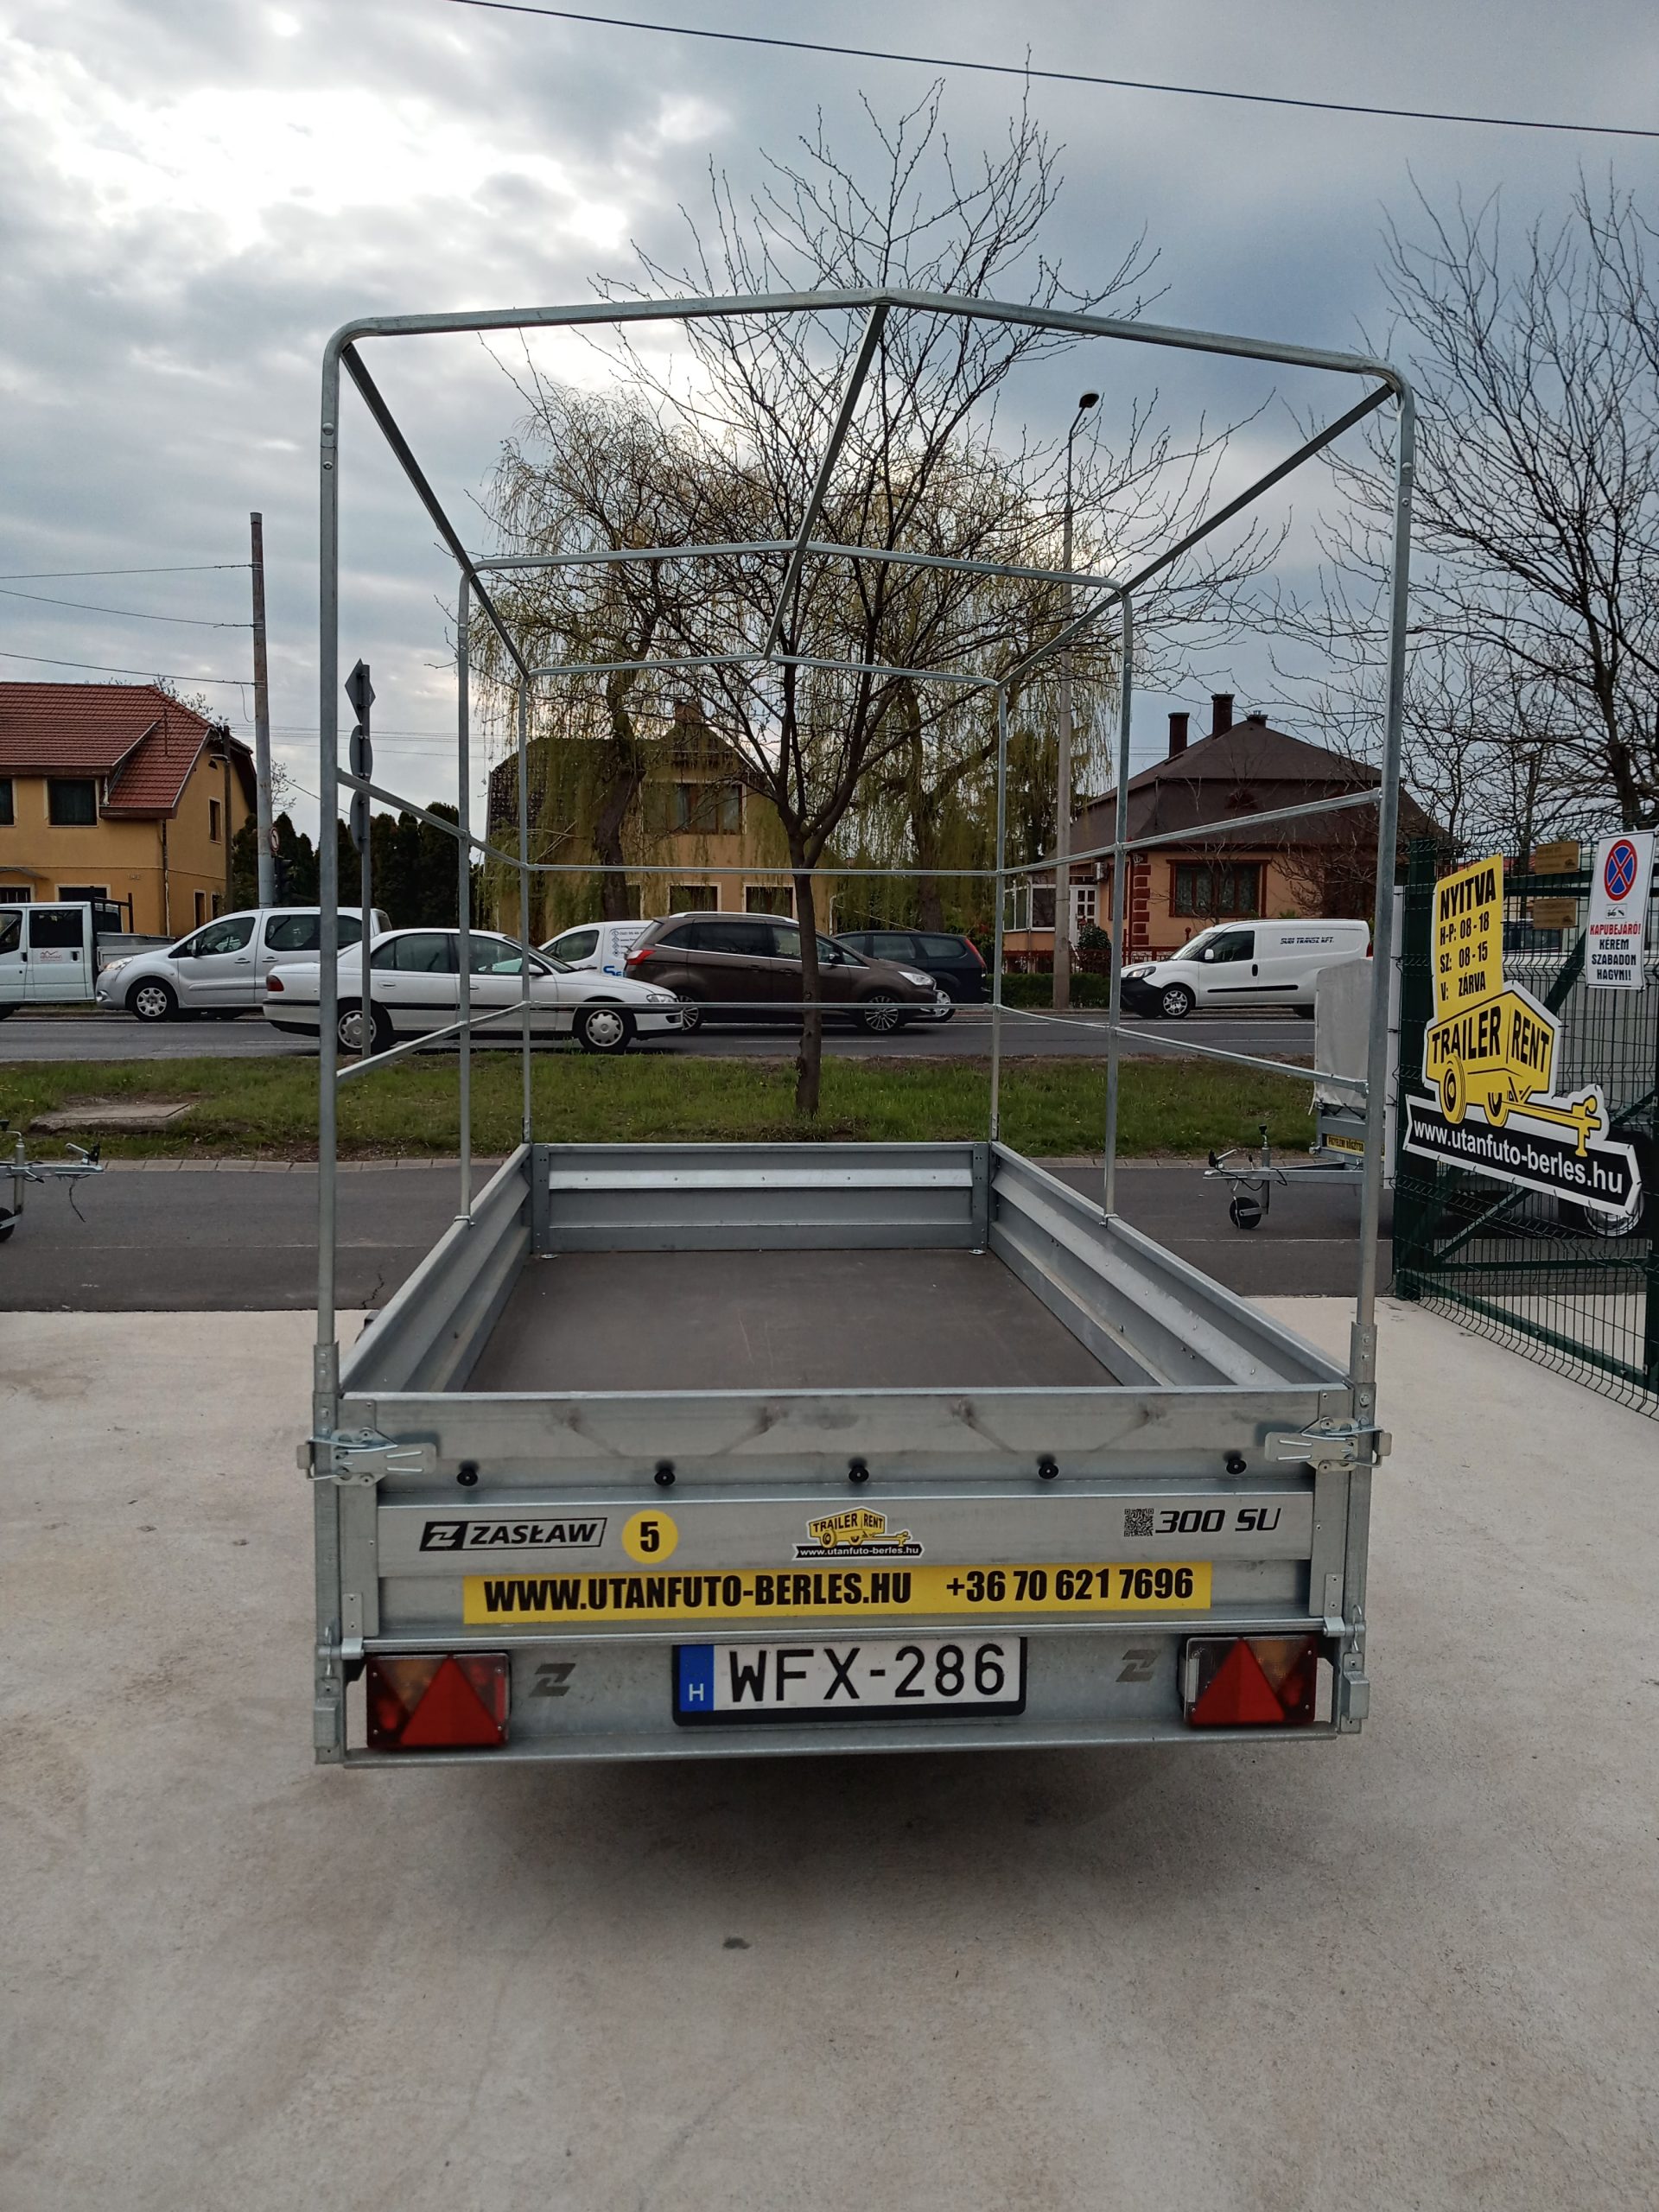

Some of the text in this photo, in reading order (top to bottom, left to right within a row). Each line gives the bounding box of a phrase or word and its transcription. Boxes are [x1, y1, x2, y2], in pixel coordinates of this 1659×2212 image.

[1440, 868, 1497, 922] NYITVA
[1440, 923, 1457, 946] H-P:
[1459, 917, 1471, 939] 08
[1478, 911, 1490, 932] 18
[1590, 921, 1641, 935] KAPUBEJÁRÓ!
[1599, 937, 1630, 950] KÉREM
[1440, 952, 1452, 974] SZ:
[1459, 946, 1471, 968] 08
[1478, 940, 1488, 962] 15
[1592, 954, 1637, 965] SZABADON
[1440, 970, 1486, 1001] V: ZÁRVA
[1597, 969, 1631, 981] HAGYNI!
[1432, 1005, 1549, 1073] TRAILER RENT
[1414, 1119, 1623, 1194] www.utanfuto-berles.hu
[469, 1522, 598, 1546] ZASŁAW
[813, 1512, 883, 1533] TRAILER RENT
[1155, 1508, 1281, 1534] 300 SU
[639, 1521, 660, 1553] 5
[799, 1546, 919, 1556] www.utanfuto-berles.hu
[484, 1567, 1193, 1612] WWW.UTANFUTO-BERLES.HU +36 70 621 7696
[689, 1643, 1005, 1703] H WFX-286
